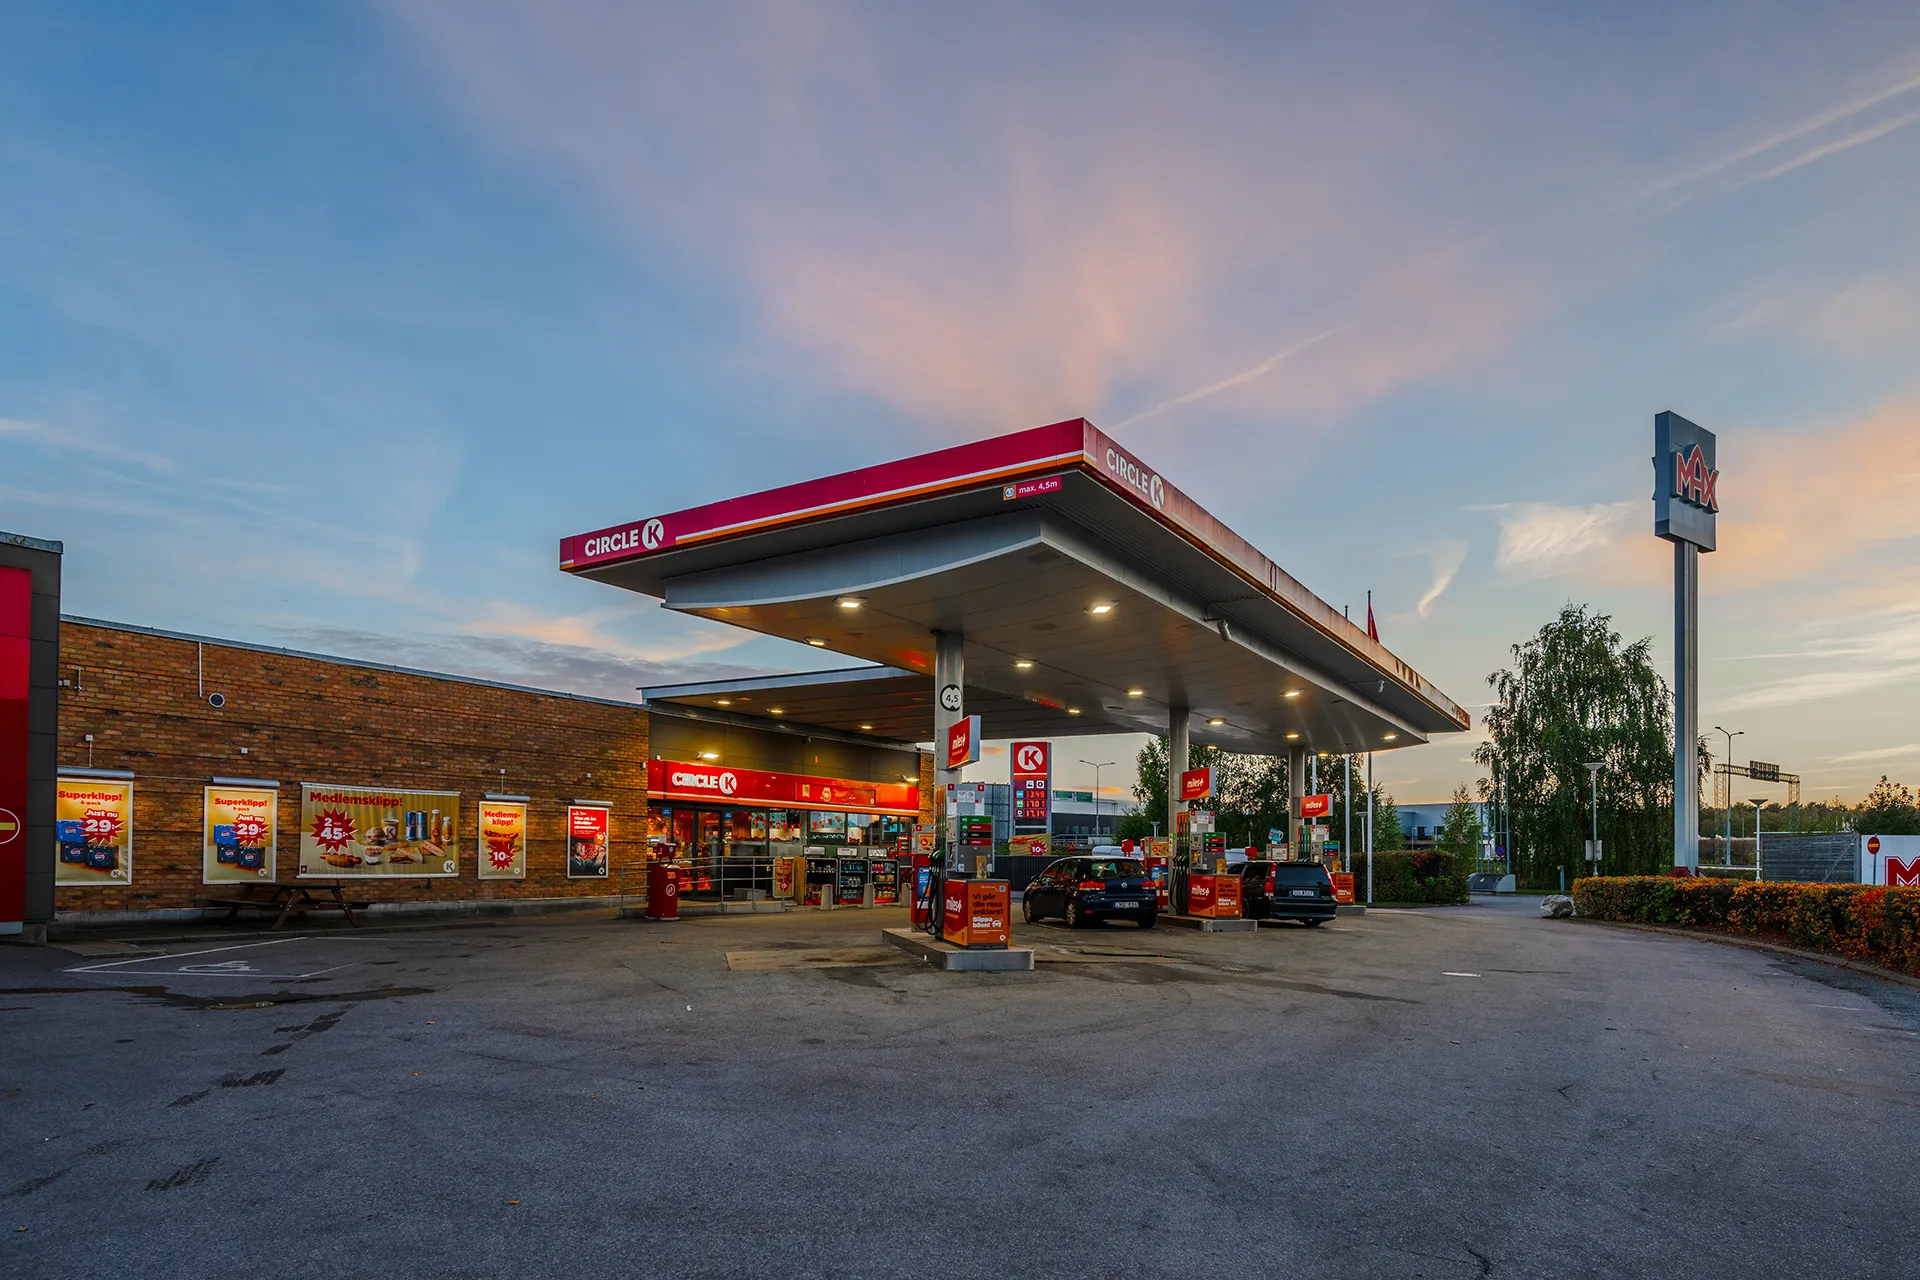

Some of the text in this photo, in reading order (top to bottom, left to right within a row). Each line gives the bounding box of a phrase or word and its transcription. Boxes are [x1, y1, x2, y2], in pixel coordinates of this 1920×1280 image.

[1106, 448, 1164, 510] CIRCLE K
[1676, 444, 1719, 512] MAX
[1038, 481, 1058, 490] 4,5m
[584, 520, 664, 557] CIRCLE K
[945, 694, 959, 703] 4,5
[1020, 747, 1043, 770] K
[671, 772, 737, 793] CIRCLE K
[58, 790, 122, 802] Superklipp!
[310, 792, 402, 808] Medlemsklipp!
[215, 798, 268, 807] Superklipp!
[86, 809, 118, 818] Just nu
[484, 811, 520, 819] Medlems-
[324, 817, 332, 826] 2
